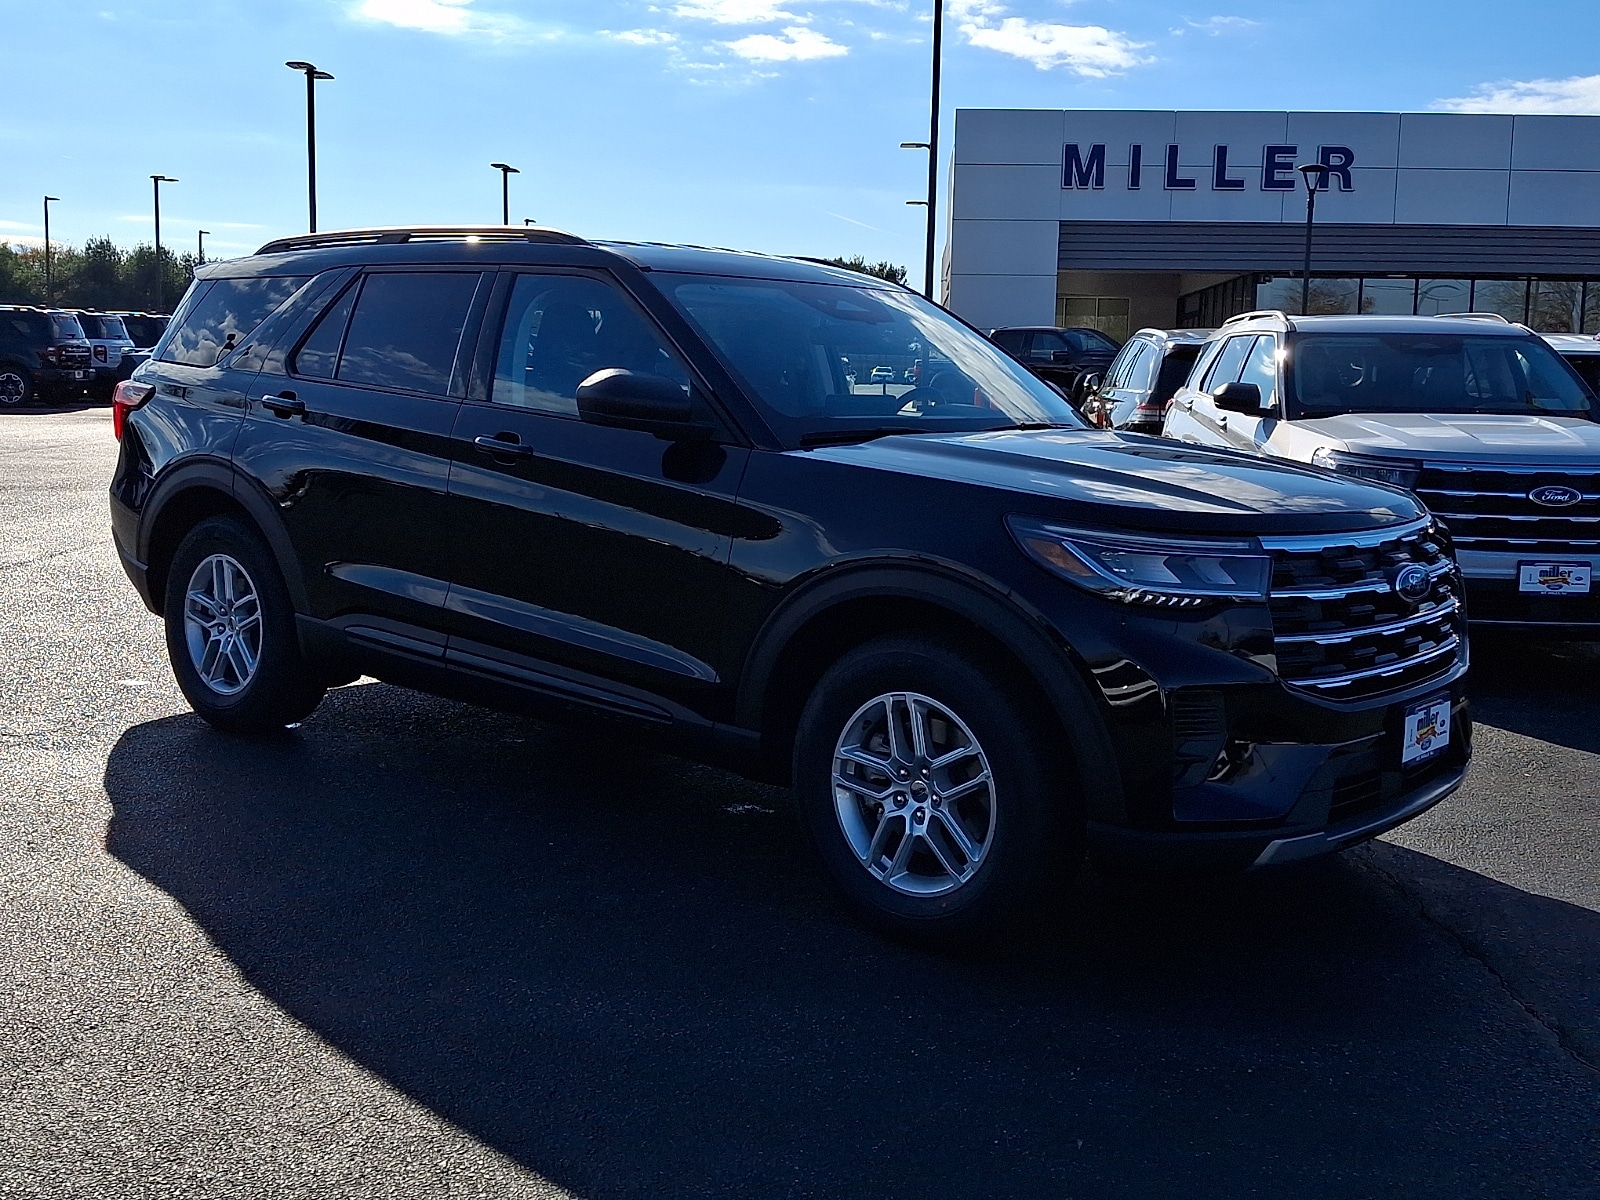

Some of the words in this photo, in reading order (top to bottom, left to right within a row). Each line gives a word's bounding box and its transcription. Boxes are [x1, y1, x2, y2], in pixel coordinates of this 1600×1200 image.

[1061, 142, 1356, 192] MILLER
[1541, 489, 1570, 501] Ford
[1538, 565, 1574, 578] miller
[1417, 707, 1440, 732] miller
